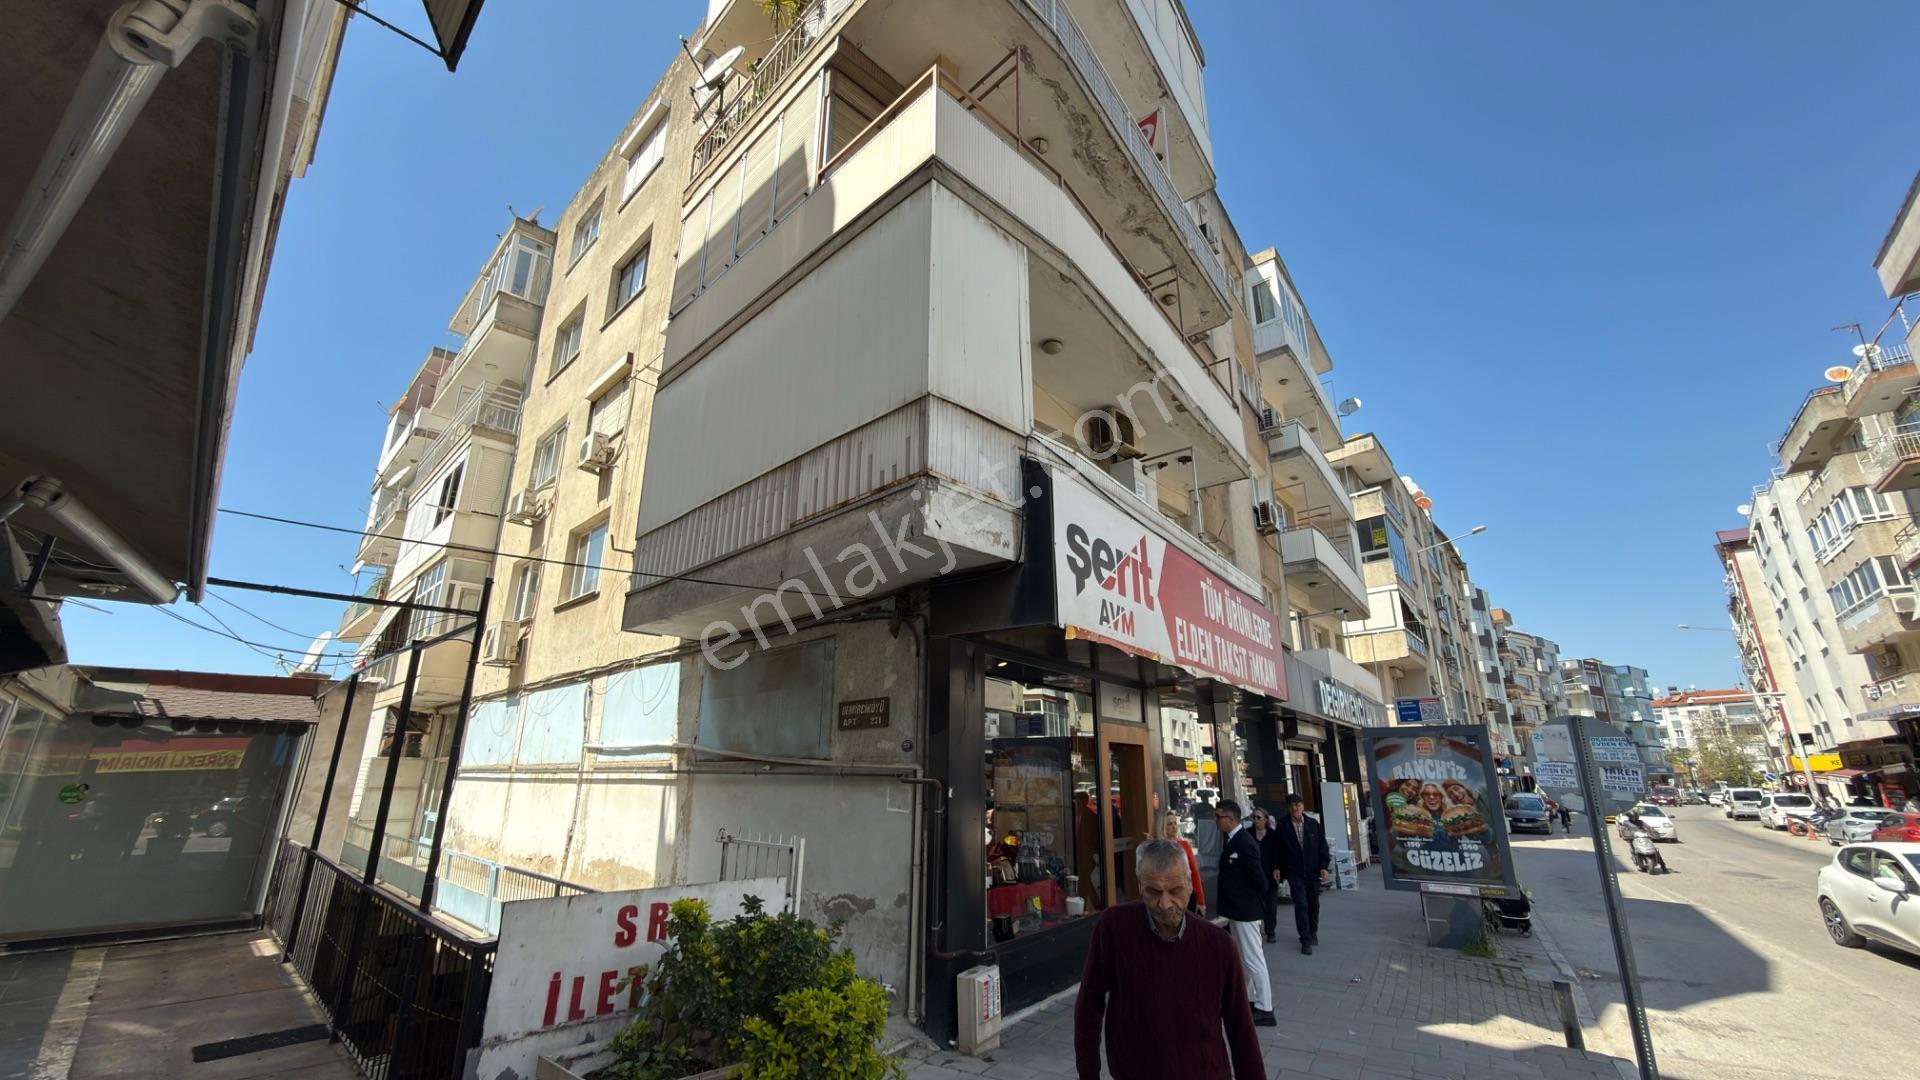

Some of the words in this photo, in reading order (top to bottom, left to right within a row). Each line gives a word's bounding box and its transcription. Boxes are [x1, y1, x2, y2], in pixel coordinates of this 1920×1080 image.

[1066, 522, 1155, 612] Şerit
[1099, 598, 1136, 638] AVM
[1200, 577, 1225, 623] TÜM
[1223, 588, 1274, 651] ÜRÜNLERDE
[1174, 615, 1215, 669] ELDEN
[1214, 635, 1249, 681] TAKSİT
[1248, 649, 1279, 691] İMKANI
